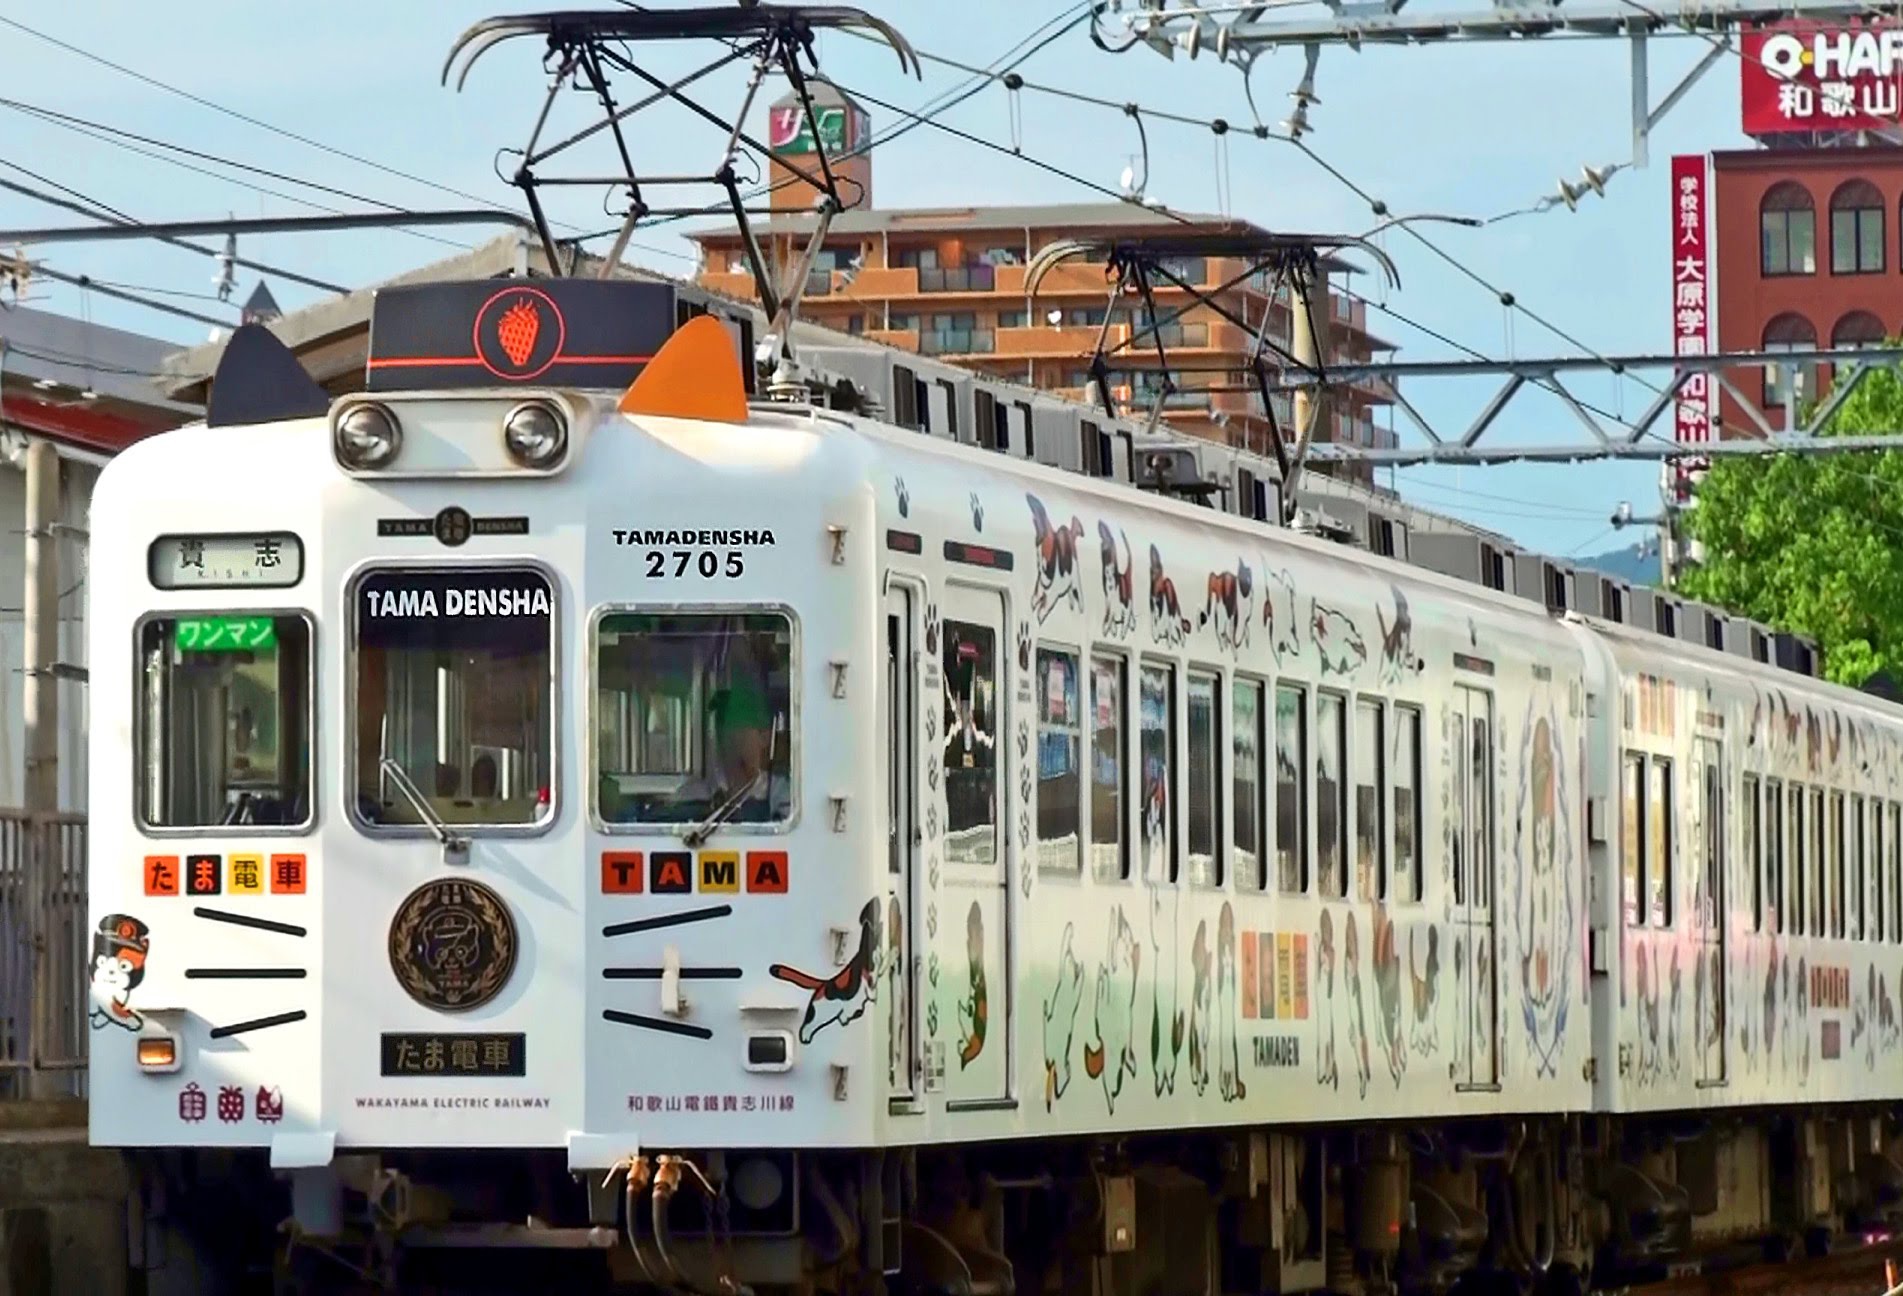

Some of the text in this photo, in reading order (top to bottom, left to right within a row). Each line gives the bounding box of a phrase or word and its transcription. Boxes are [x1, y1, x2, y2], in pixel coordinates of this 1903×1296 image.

[612, 530, 776, 545] TAMADENSHA
[645, 551, 744, 578] 2705
[367, 588, 550, 617] TAMA DENSHA
[179, 620, 272, 647] ワンマン
[152, 860, 301, 890] たま電車
[611, 861, 781, 885] TAMA
[395, 1038, 511, 1071] たま電車
[1253, 1036, 1300, 1067] TAMADEN
[356, 1097, 551, 1108] WAKAYAMA ELECTRIC RAILWAY
